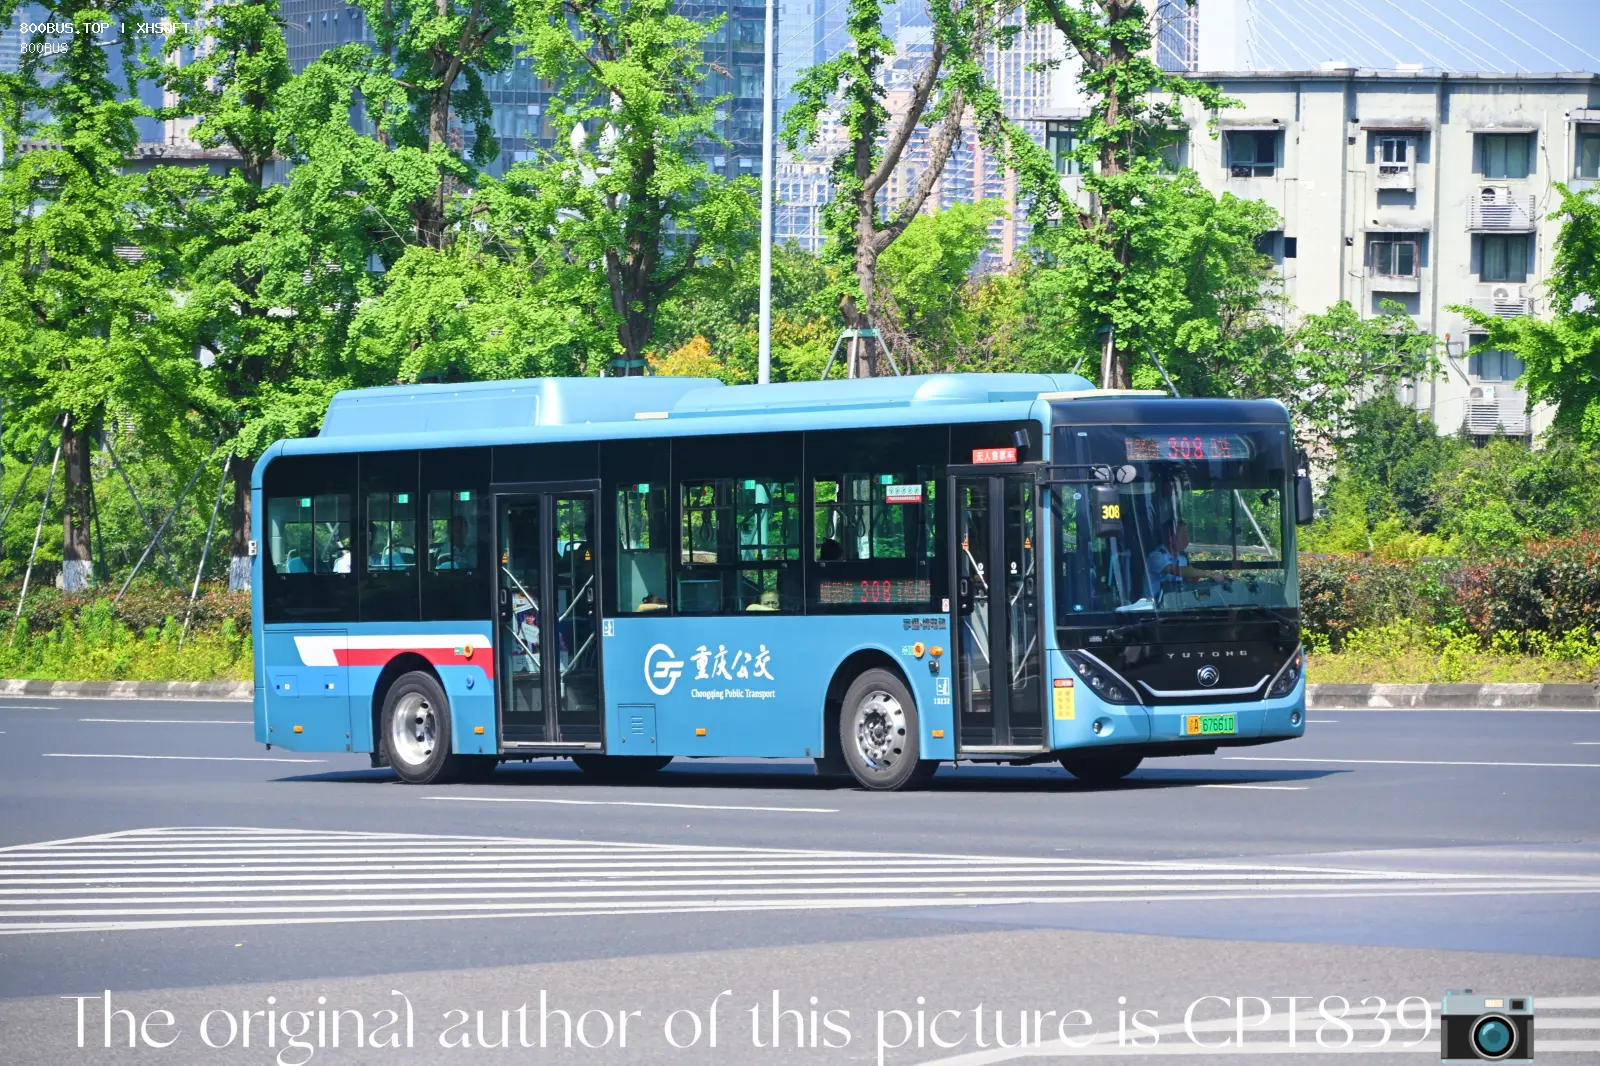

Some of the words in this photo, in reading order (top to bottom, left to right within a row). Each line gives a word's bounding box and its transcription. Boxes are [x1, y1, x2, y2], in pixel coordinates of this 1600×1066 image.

[1167, 436, 1204, 460] 308
[1101, 504, 1120, 520] 308
[860, 580, 892, 603] 308
[689, 644, 775, 681] 重庆公交
[1166, 650, 1248, 659] YUTONG
[691, 689, 724, 700] Chongqing
[724, 689, 745, 698] Public
[744, 689, 776, 700] Transport
